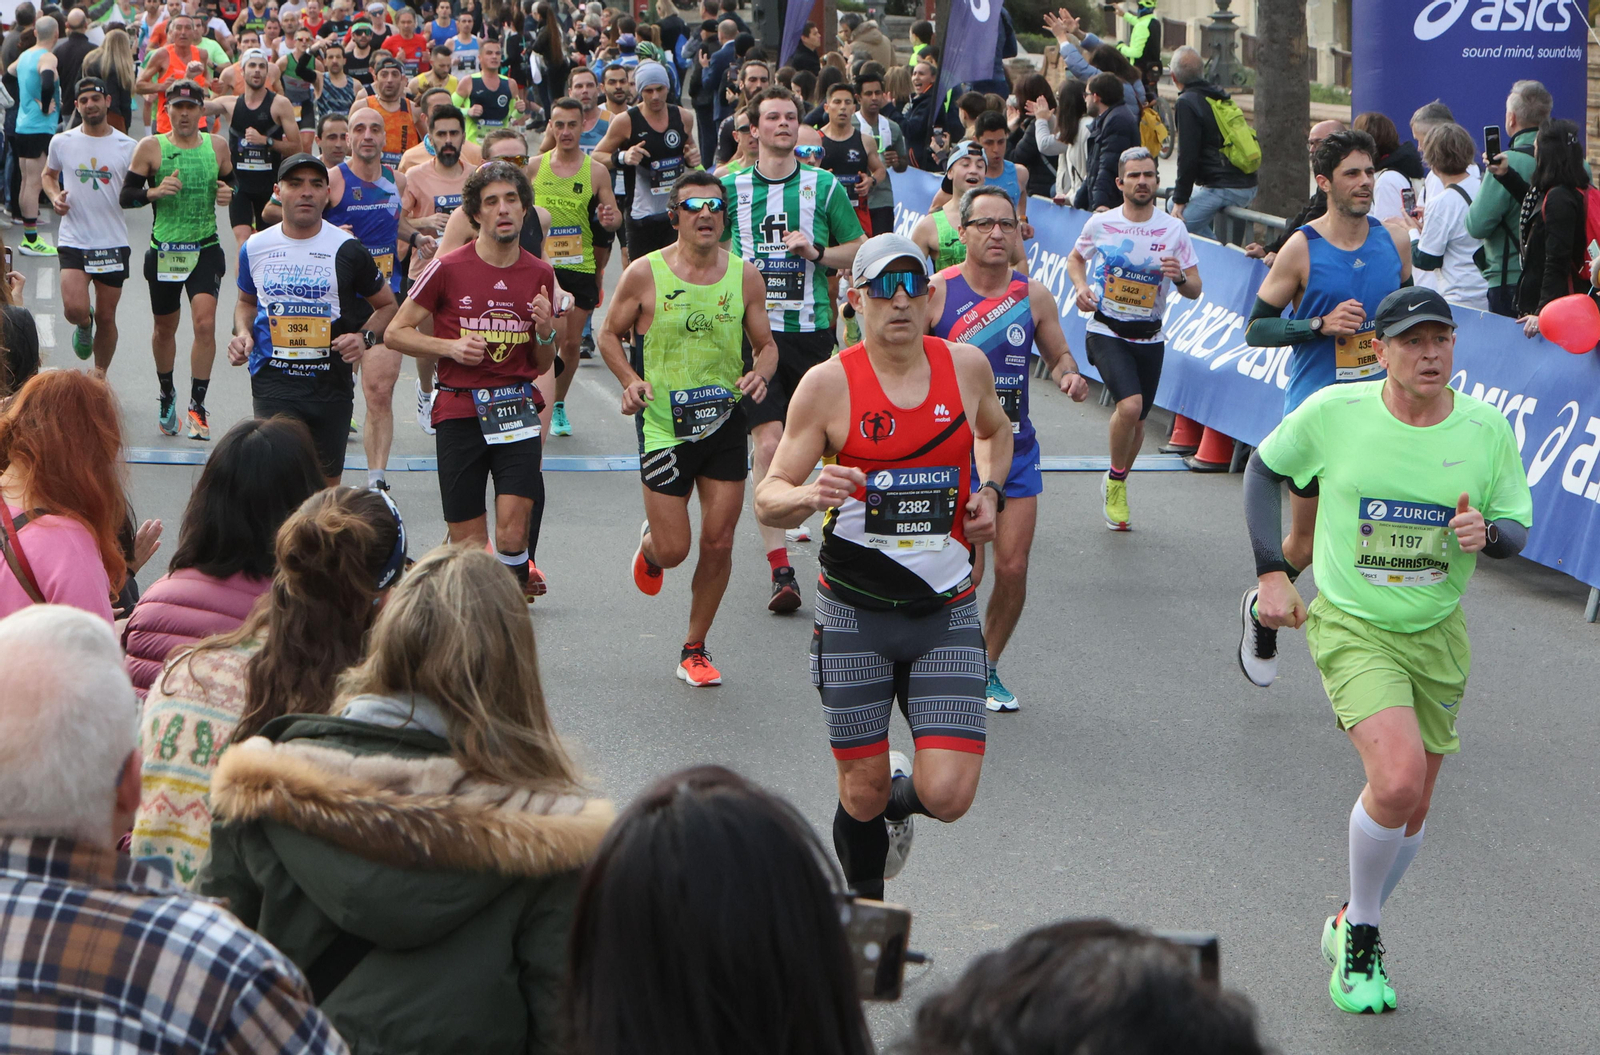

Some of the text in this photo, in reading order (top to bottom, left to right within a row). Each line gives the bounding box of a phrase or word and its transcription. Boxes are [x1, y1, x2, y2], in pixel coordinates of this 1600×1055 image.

[1462, 45, 1582, 62] sound mind, sound body
[263, 264, 332, 277] RUNNERS
[1125, 271, 1154, 282] ZURICH
[768, 278, 786, 286] 2594
[1122, 285, 1139, 294] 5423
[288, 305, 324, 314] ZURICH
[956, 296, 1016, 344] Atletismo LEBRIJA
[963, 310, 979, 325] Club
[288, 324, 308, 332] 3934
[1172, 302, 1244, 358] asics
[1358, 320, 1376, 330] ZUR
[290, 338, 307, 346] RAÚL
[1358, 340, 1372, 349] 435
[995, 376, 1019, 385] URICH
[494, 386, 524, 398] ZURICH
[692, 387, 727, 399] ZURICH
[496, 405, 517, 417] 2111
[695, 407, 717, 420] 3022
[499, 420, 524, 431] LUISMI
[899, 472, 950, 485] ZURICH
[898, 500, 930, 514] 2382
[1393, 506, 1446, 522] ZURICH
[897, 522, 931, 533] REACO
[1390, 534, 1422, 548] 1197
[1357, 554, 1449, 570] JEAN-CHRISTOPH
